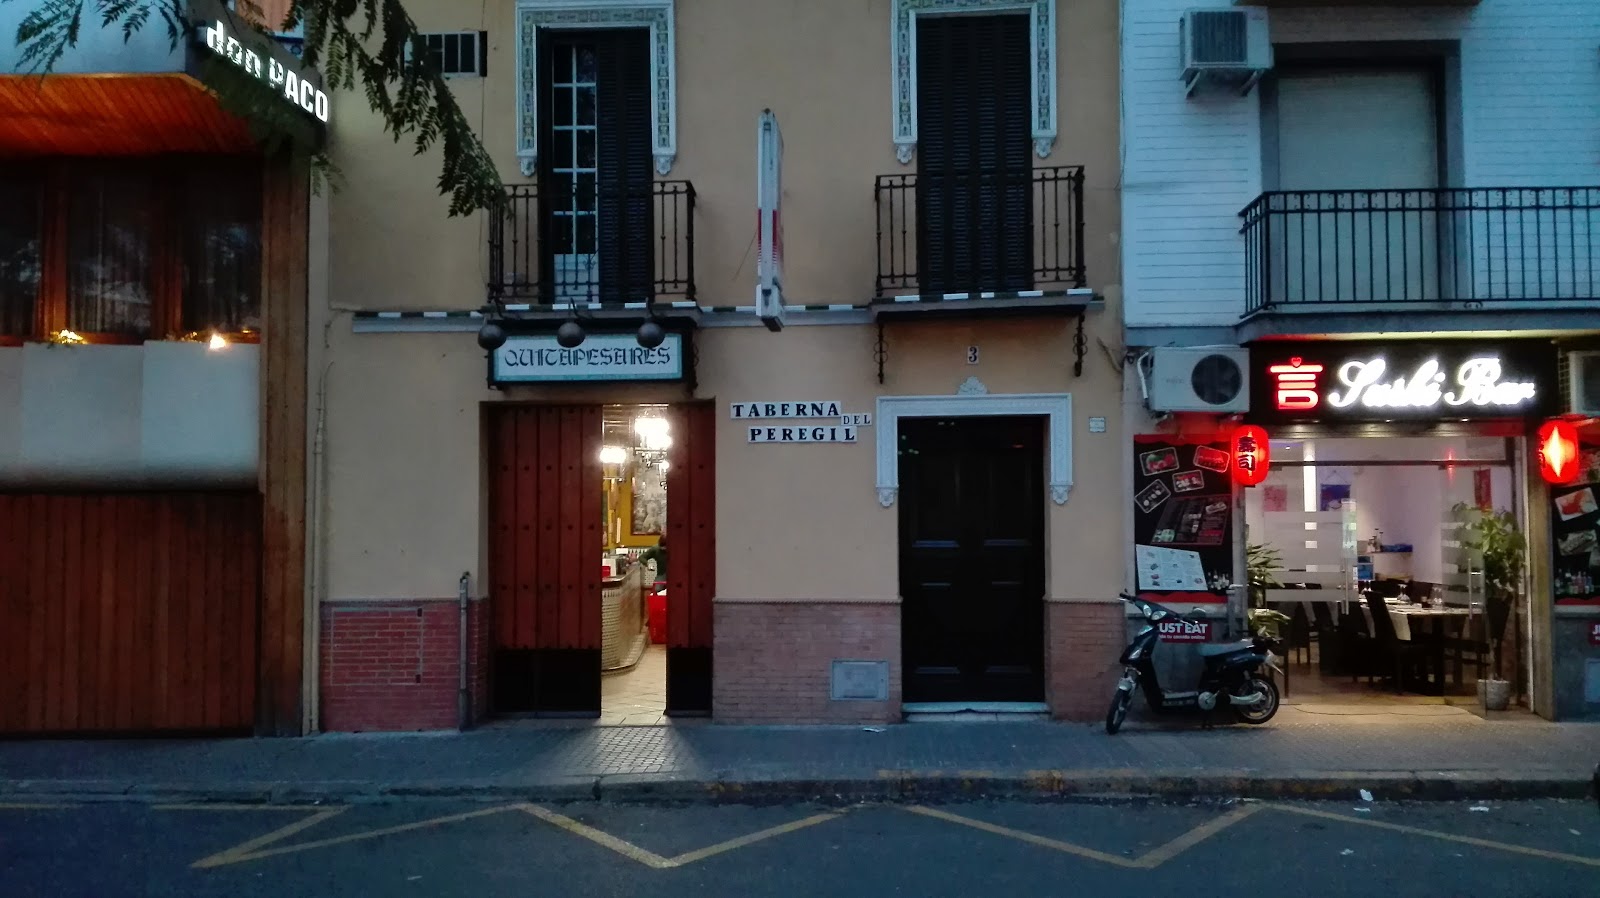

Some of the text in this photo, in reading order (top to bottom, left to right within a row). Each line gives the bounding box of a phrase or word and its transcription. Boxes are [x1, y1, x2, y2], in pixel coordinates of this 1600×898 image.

[206, 20, 328, 122] don PACO
[504, 347, 671, 367] QUITAPESARES
[968, 346, 978, 363] 3
[1328, 357, 1537, 408] Sushi Bar
[732, 403, 839, 417] TABERNA
[843, 415, 871, 425] DEL
[750, 427, 855, 441] PEREGIL
[1157, 623, 1208, 634] UST EAT
